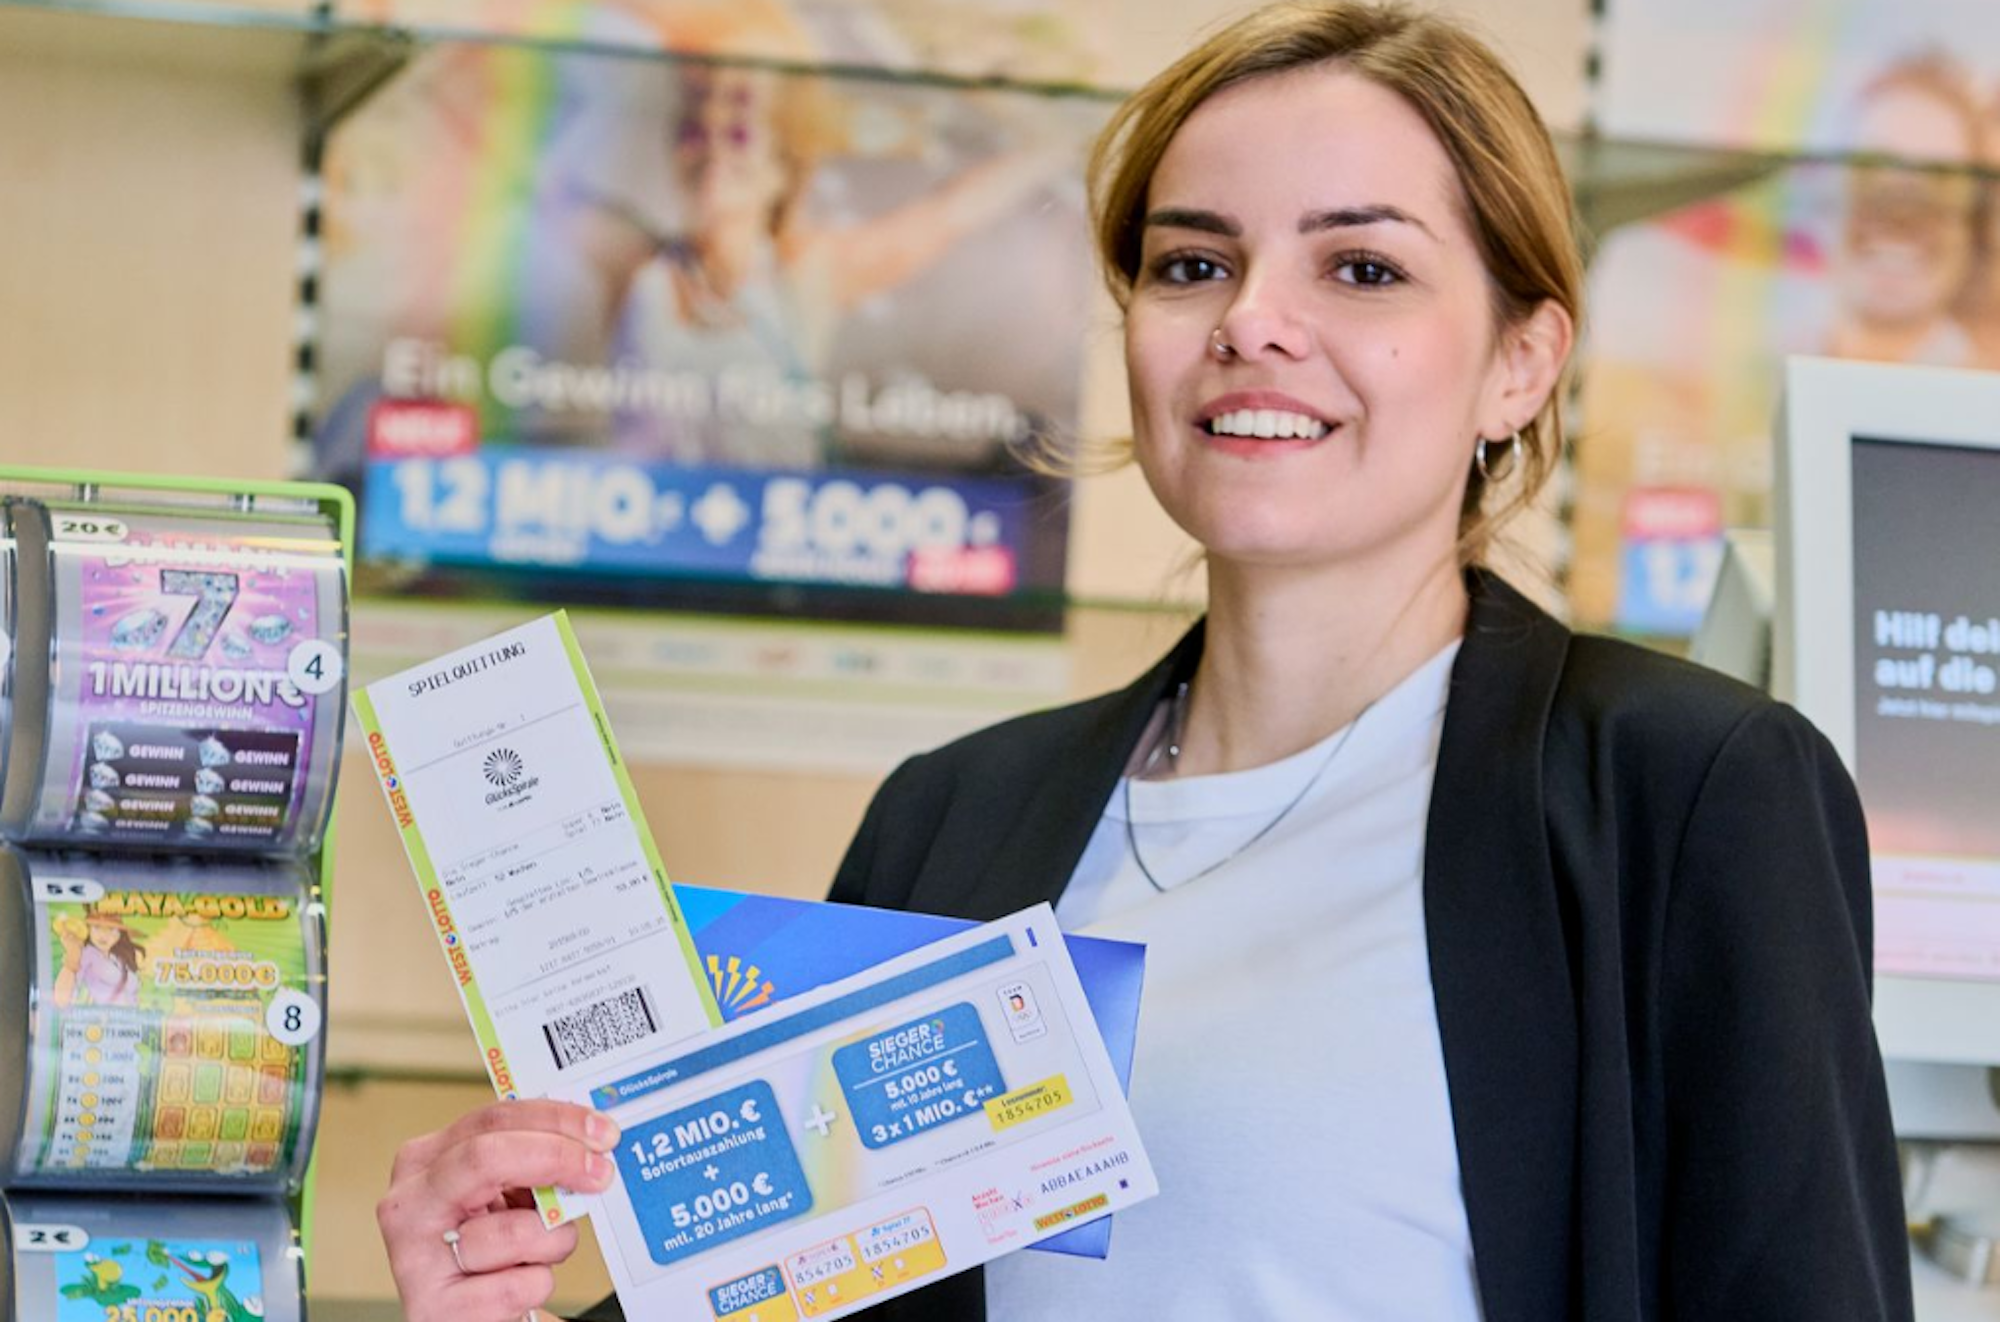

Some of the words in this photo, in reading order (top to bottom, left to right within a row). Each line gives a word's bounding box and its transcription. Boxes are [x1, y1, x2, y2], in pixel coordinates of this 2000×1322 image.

[62, 521, 98, 534] 20
[104, 524, 121, 534] €
[160, 568, 240, 661] 7
[1875, 609, 1940, 649] Hilf
[305, 653, 324, 680] 4
[408, 641, 526, 698] SPIELQUITTUNG
[1875, 653, 1934, 690] auf
[1939, 656, 1996, 695] die
[129, 744, 184, 760] GEWINN
[234, 751, 289, 766] GEWINN
[368, 731, 397, 779] LOTTO
[125, 773, 180, 788] GEWINN
[230, 779, 284, 793] GEWINN
[120, 799, 175, 812] GEWINN
[224, 804, 279, 817] GEWINN
[389, 788, 414, 829] WEST
[428, 888, 451, 934] LOTTO
[447, 945, 472, 987] WEST
[284, 1004, 301, 1034] 8
[868, 1023, 931, 1059] SIEGER
[871, 1034, 945, 1074] CHANCE
[885, 1066, 941, 1100] 5.000
[942, 1059, 959, 1077] €
[914, 1099, 963, 1128] MIO.
[997, 1090, 1063, 1124] 1854705
[631, 1132, 674, 1167] 1,2
[674, 1111, 740, 1150] MIO.
[740, 1099, 762, 1123] €
[641, 1125, 767, 1182] Sofortauszahlung
[670, 1181, 749, 1229] 5.000
[752, 1171, 775, 1197] €
[695, 1220, 715, 1240] 20
[717, 1208, 755, 1232] Jahre
[864, 1225, 931, 1258] 1854705
[717, 1273, 767, 1300] SIEGER
[795, 1255, 853, 1284] 854705
[720, 1281, 778, 1314] CHANCE
